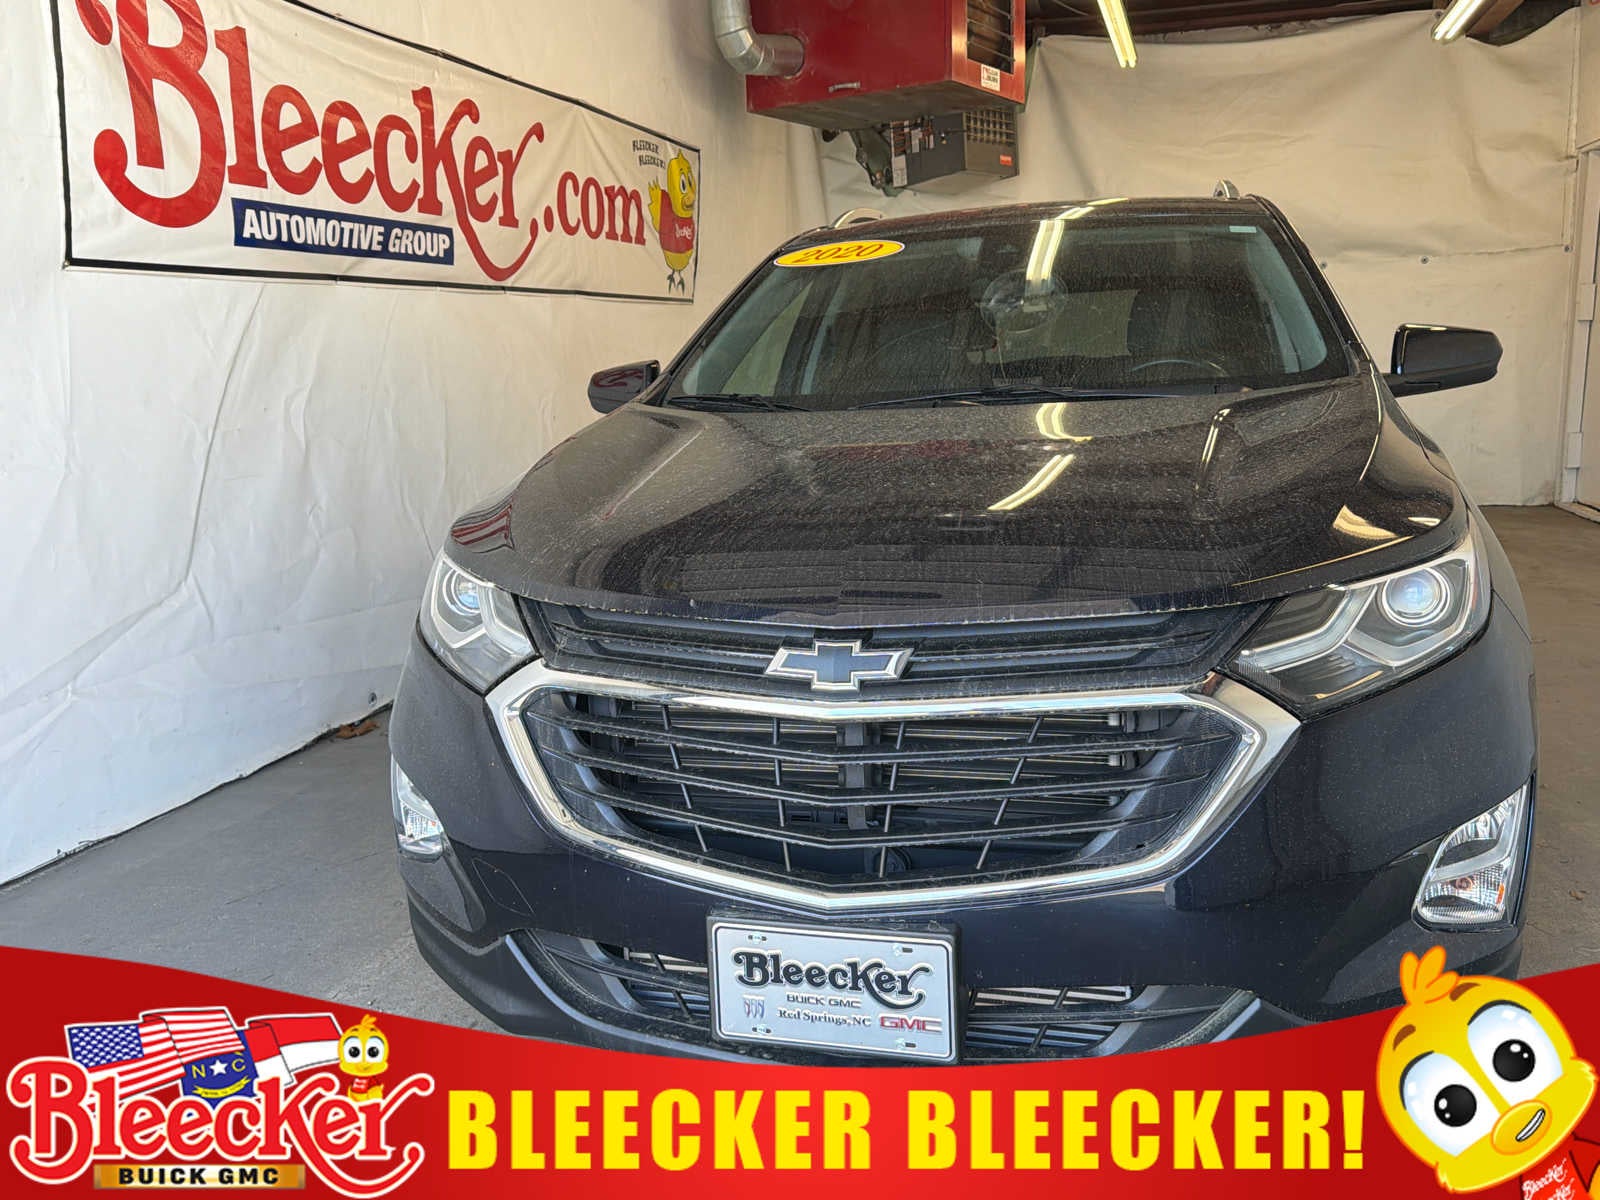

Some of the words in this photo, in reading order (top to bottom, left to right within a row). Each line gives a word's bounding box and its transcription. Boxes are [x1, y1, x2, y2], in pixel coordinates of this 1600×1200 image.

[242, 208, 385, 253] AUTOMOTIVE
[388, 227, 450, 258] GROUP
[791, 243, 884, 263] 2020
[733, 950, 931, 1010] Bleecker
[786, 993, 825, 1006] BUICK
[828, 997, 862, 1009] GMC
[777, 1008, 801, 1020] Red
[879, 1015, 942, 1033] GMC
